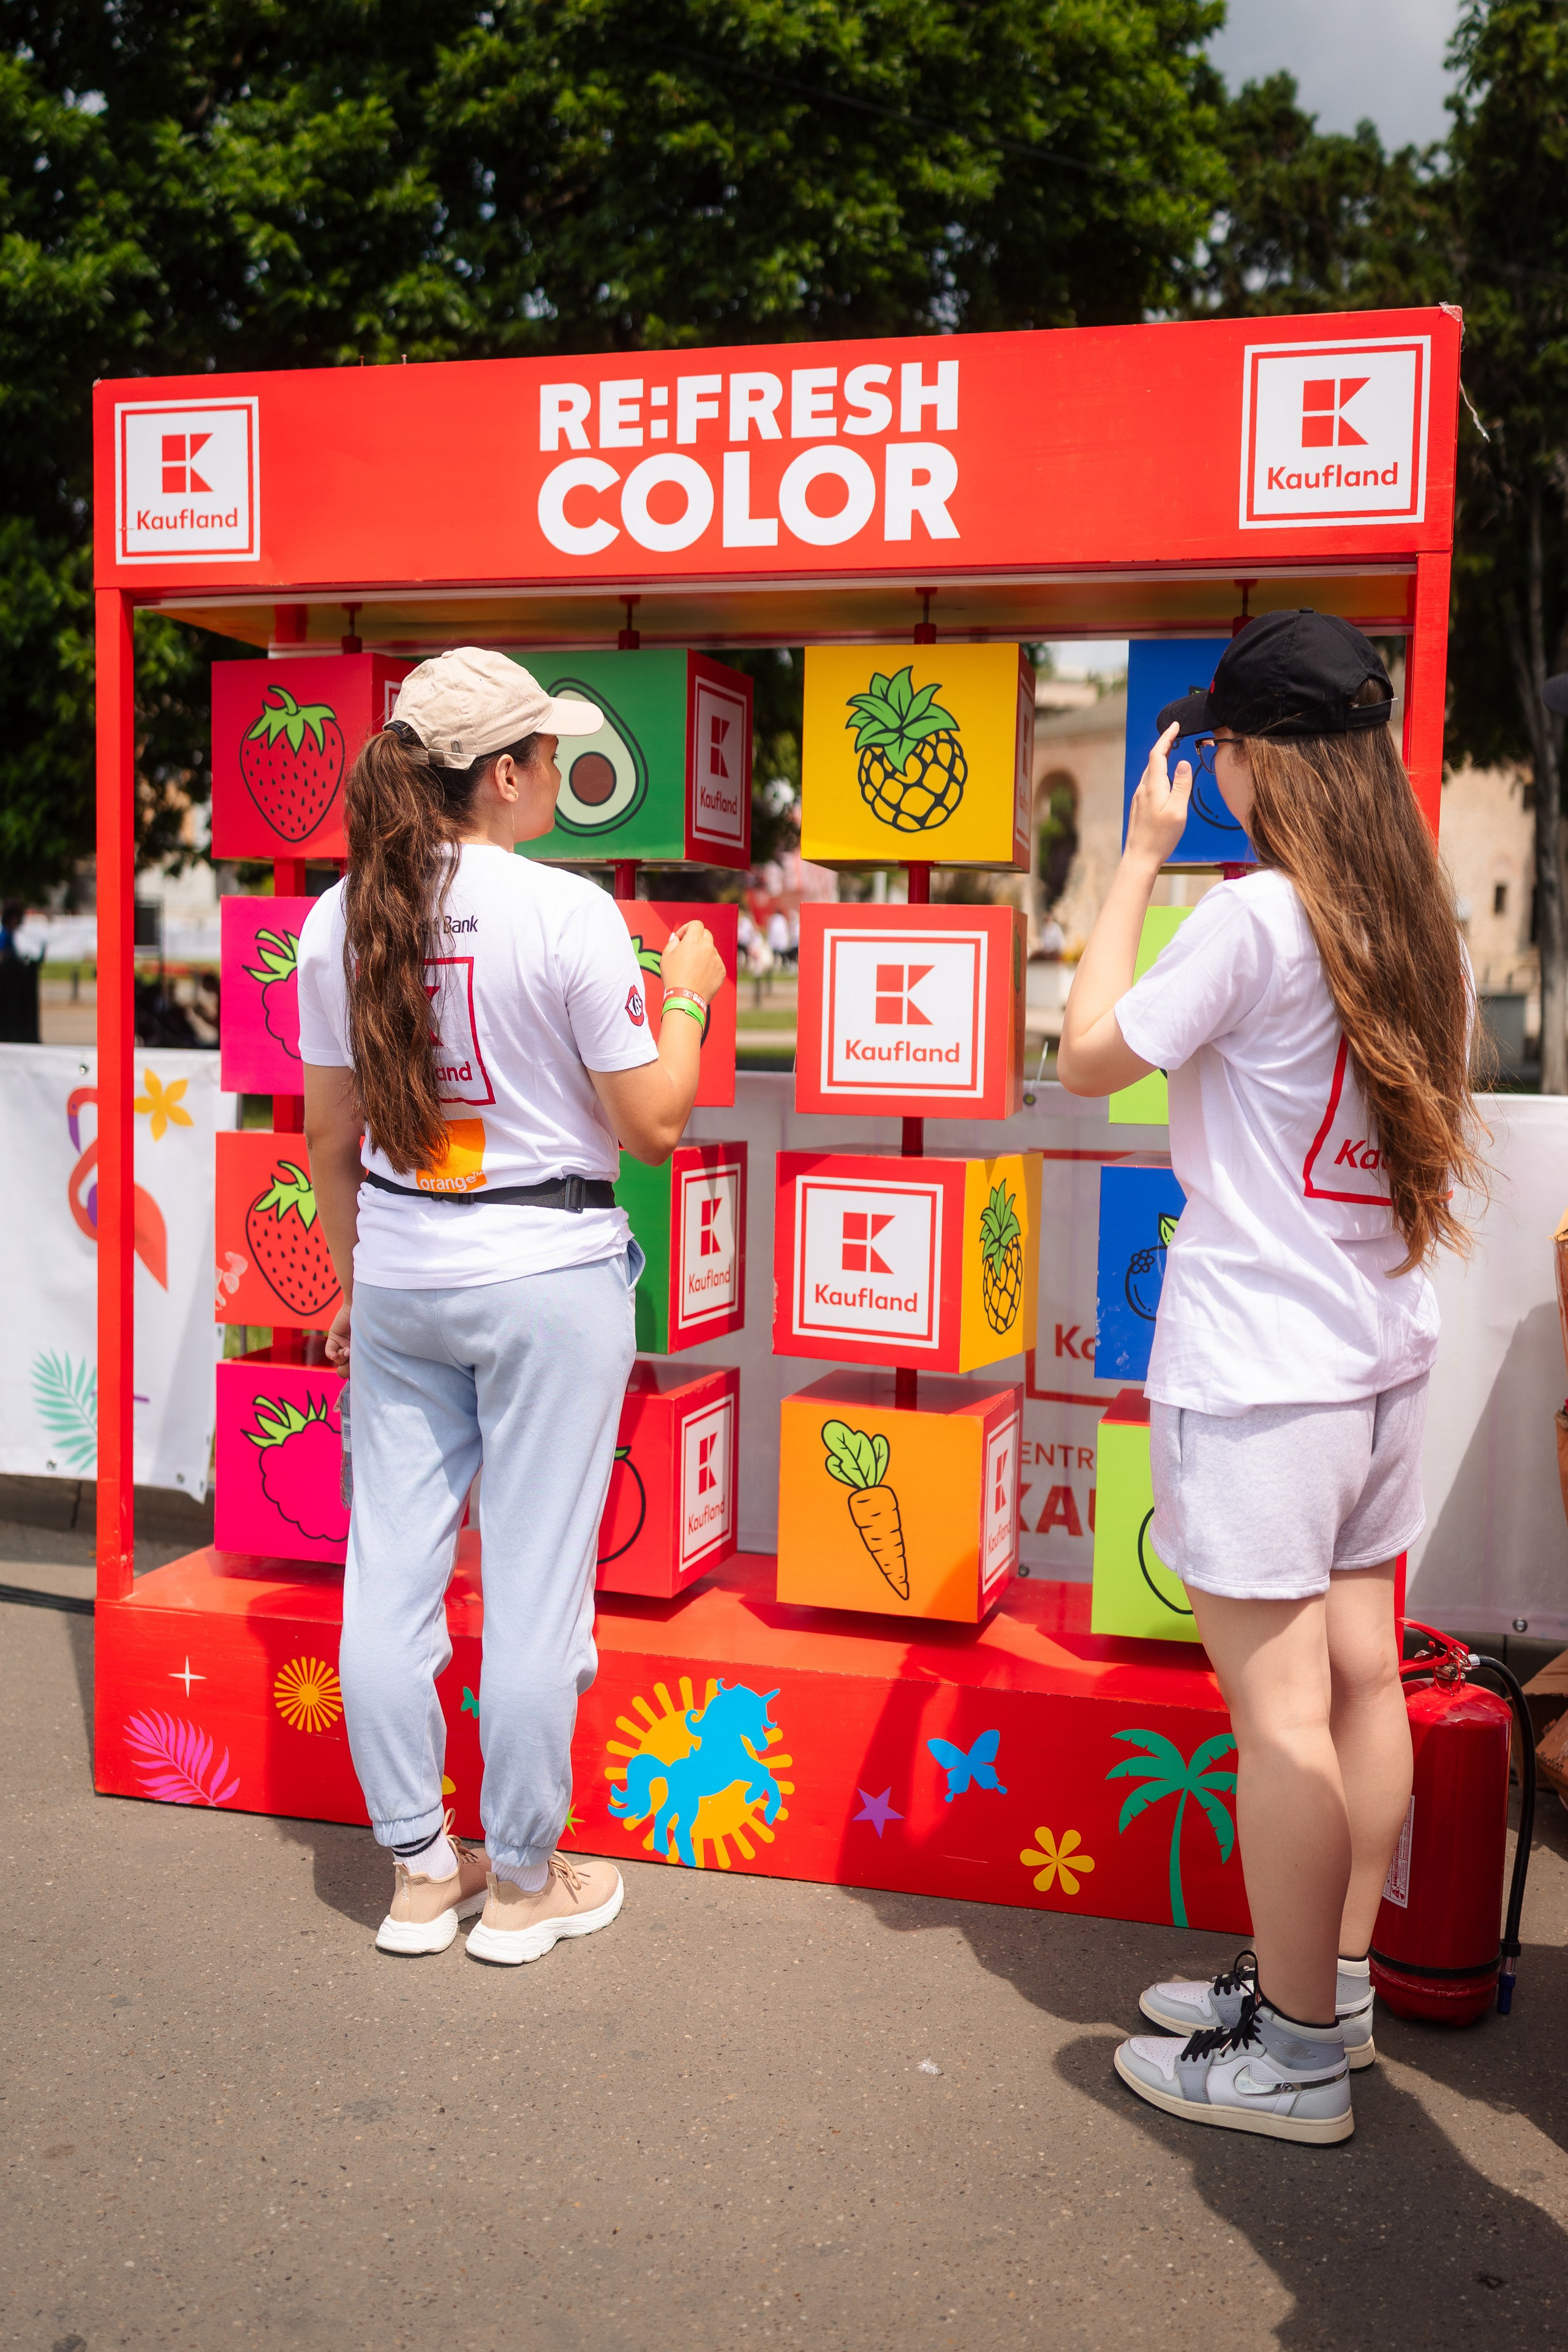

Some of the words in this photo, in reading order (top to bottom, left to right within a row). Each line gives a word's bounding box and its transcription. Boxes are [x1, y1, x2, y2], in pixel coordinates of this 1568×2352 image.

[540, 360, 959, 451] RE:FRESH
[1268, 462, 1398, 490] Kaufland
[538, 442, 960, 556] COLOR
[137, 508, 238, 530] Kaufland
[700, 786, 737, 815] Kaufland
[443, 915, 478, 933] Bank
[845, 1039, 960, 1063] Kaufland
[435, 1061, 472, 1081] and
[1334, 1139, 1387, 1169] Ka
[688, 1264, 731, 1294] Kaufland
[815, 1284, 918, 1313] Kaufland
[1022, 1441, 1095, 1470] ENTR
[688, 1494, 726, 1536] Kaufland
[988, 1517, 1011, 1556] Kaufland
[1536, 1751, 1564, 1774] ollection
